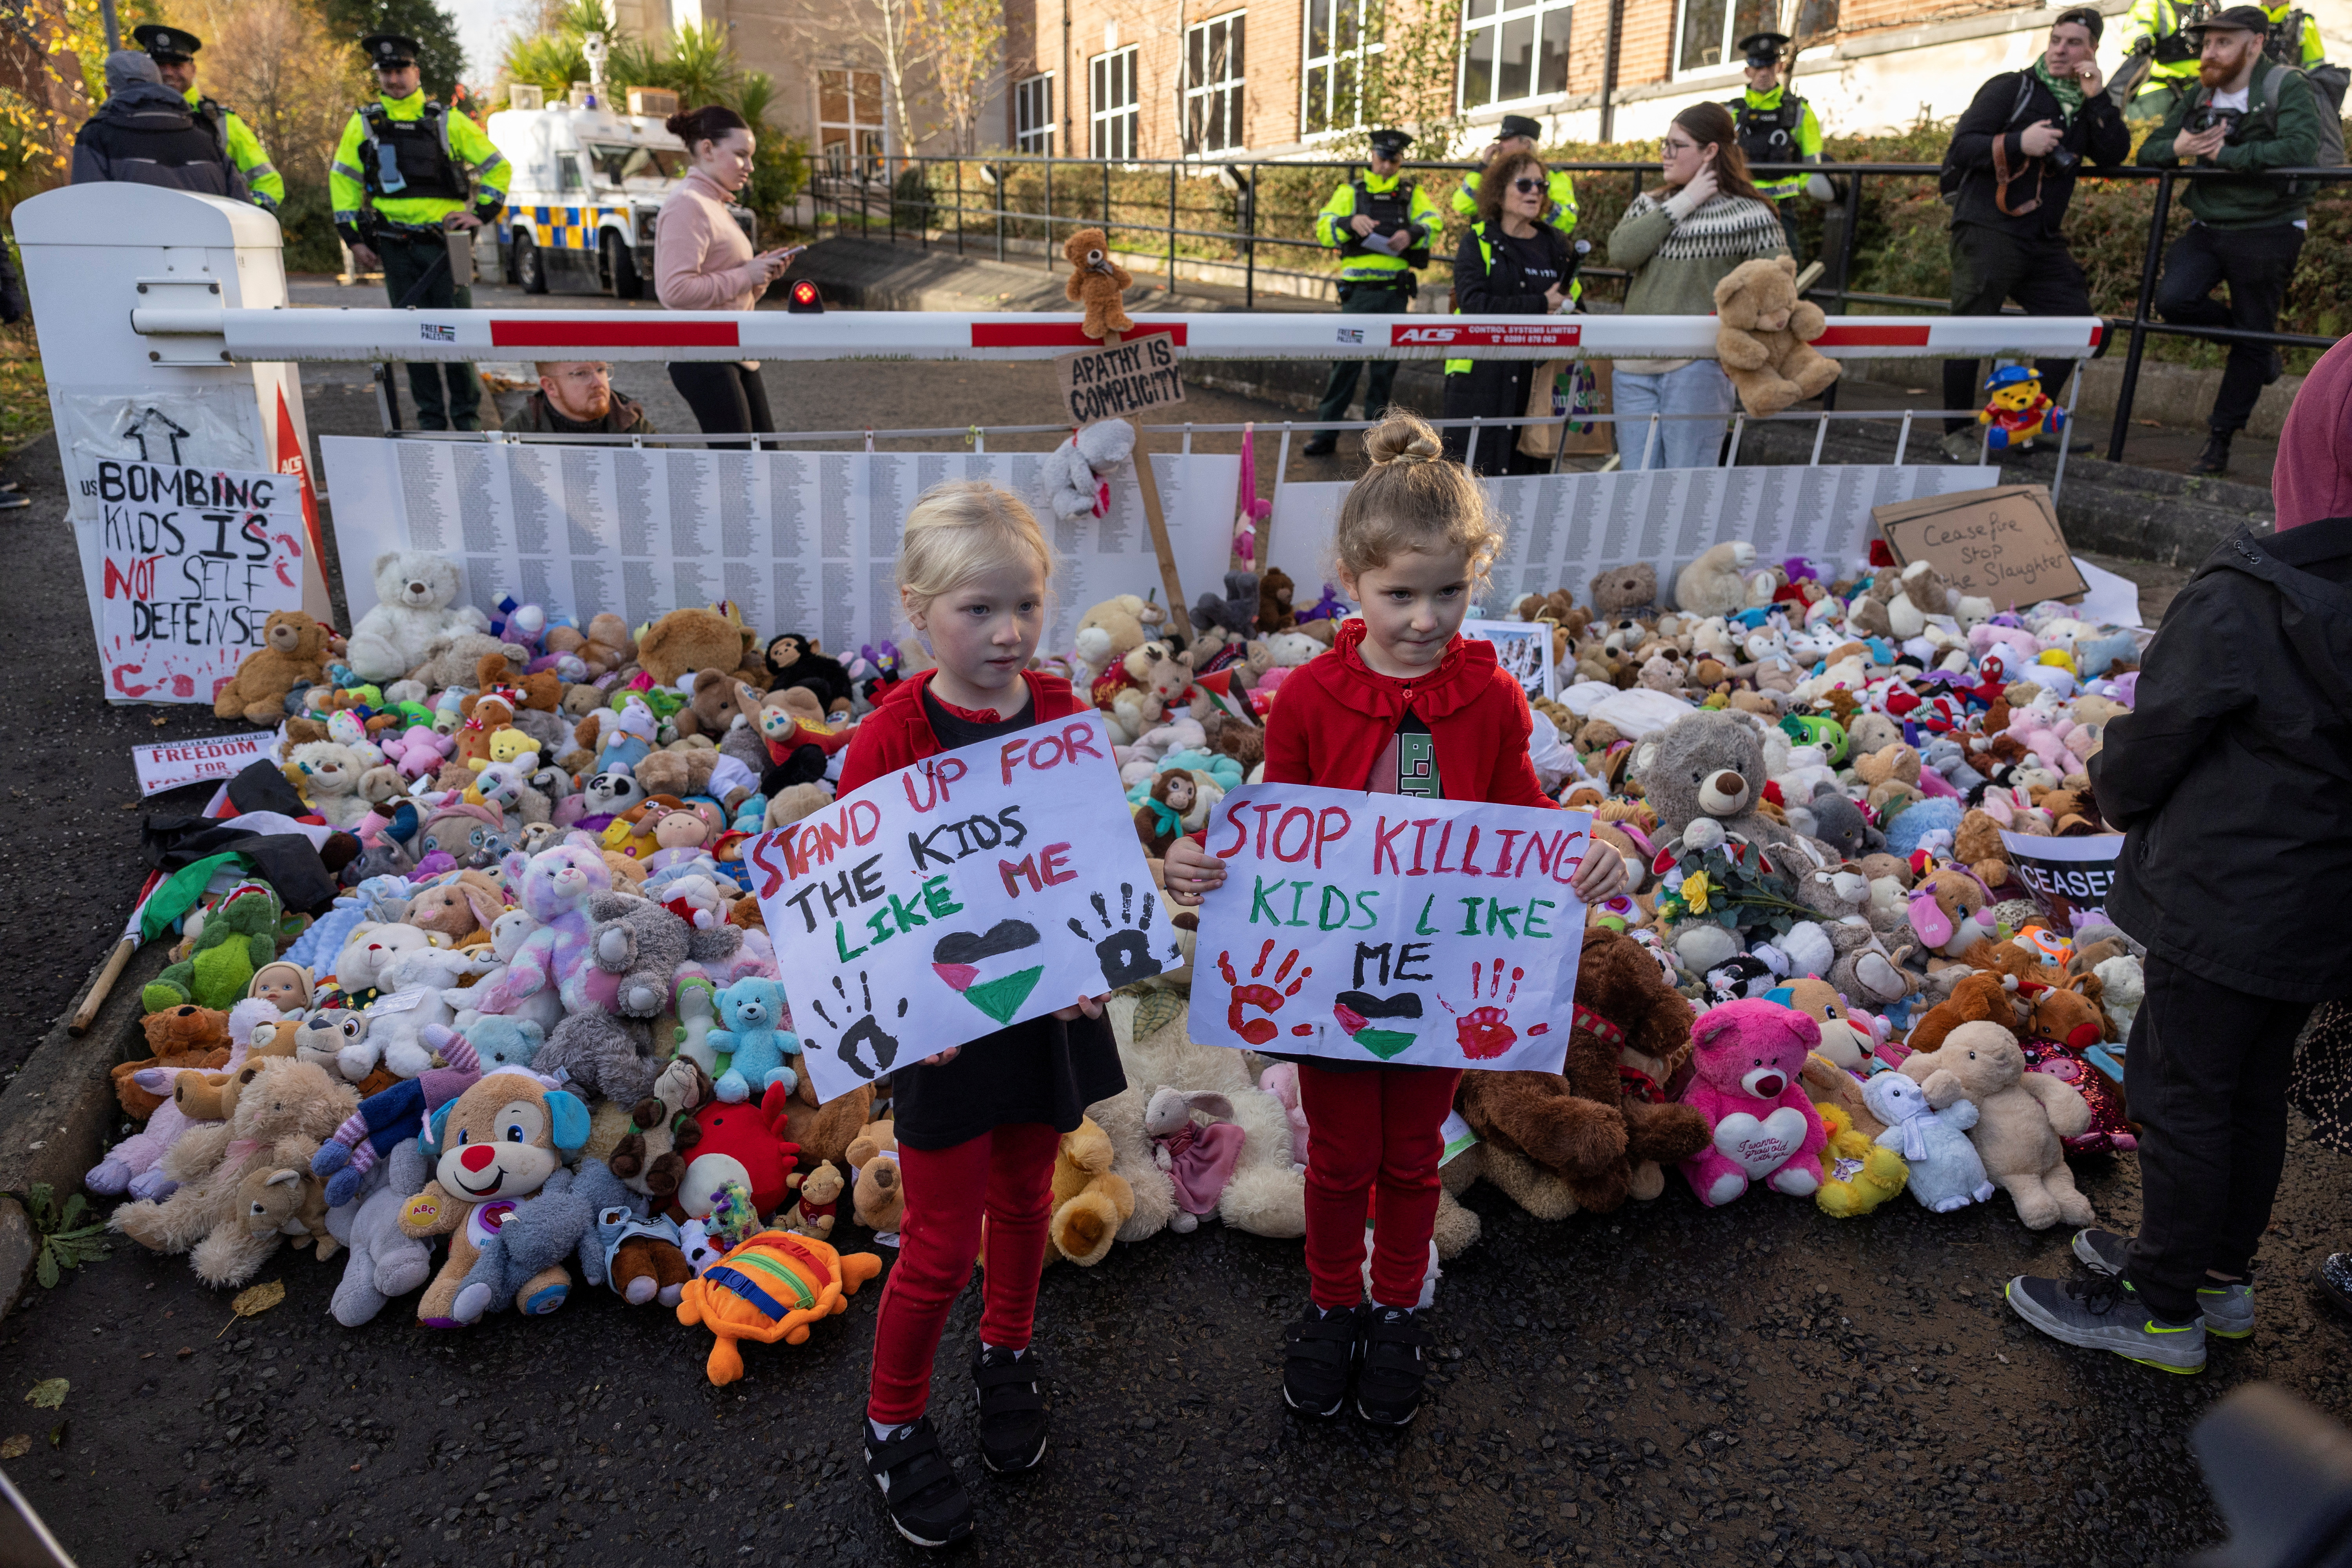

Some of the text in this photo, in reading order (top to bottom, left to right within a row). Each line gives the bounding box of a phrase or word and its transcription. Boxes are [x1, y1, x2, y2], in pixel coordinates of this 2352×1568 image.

[421, 323, 436, 333] FREE
[421, 332, 455, 342] PALESTINE
[1396, 328, 1457, 342] ACS
[1469, 325, 1578, 334] CONTROL SYSTEMS LIMITED
[1073, 339, 1172, 386] APATHY IS
[1070, 365, 1181, 423] COMPLICITY
[99, 462, 277, 510] BOMBING
[104, 505, 270, 561] KIDS IS
[103, 554, 272, 603] NOT SELF
[1984, 553, 2065, 587] Slaughter
[133, 600, 271, 647] DEFENSE
[152, 741, 258, 763] FREEDOM
[194, 762, 227, 773] FOR
[753, 722, 1103, 899] STAND UP FOR
[1216, 800, 1584, 885] STOP KILLING
[786, 805, 1027, 933] THE KIDS
[836, 841, 1078, 963] LIKE ME
[1249, 875, 1555, 940] KIDS LIKE
[1925, 924, 1938, 932] EAR
[1353, 941, 1434, 990] ME
[1737, 1138, 1779, 1152] I wanna
[1745, 1141, 1789, 1159] grow old
[1753, 1152, 1771, 1162] with
[413, 1204, 436, 1215] ABC
[902, 1426, 911, 1435] NIKE
